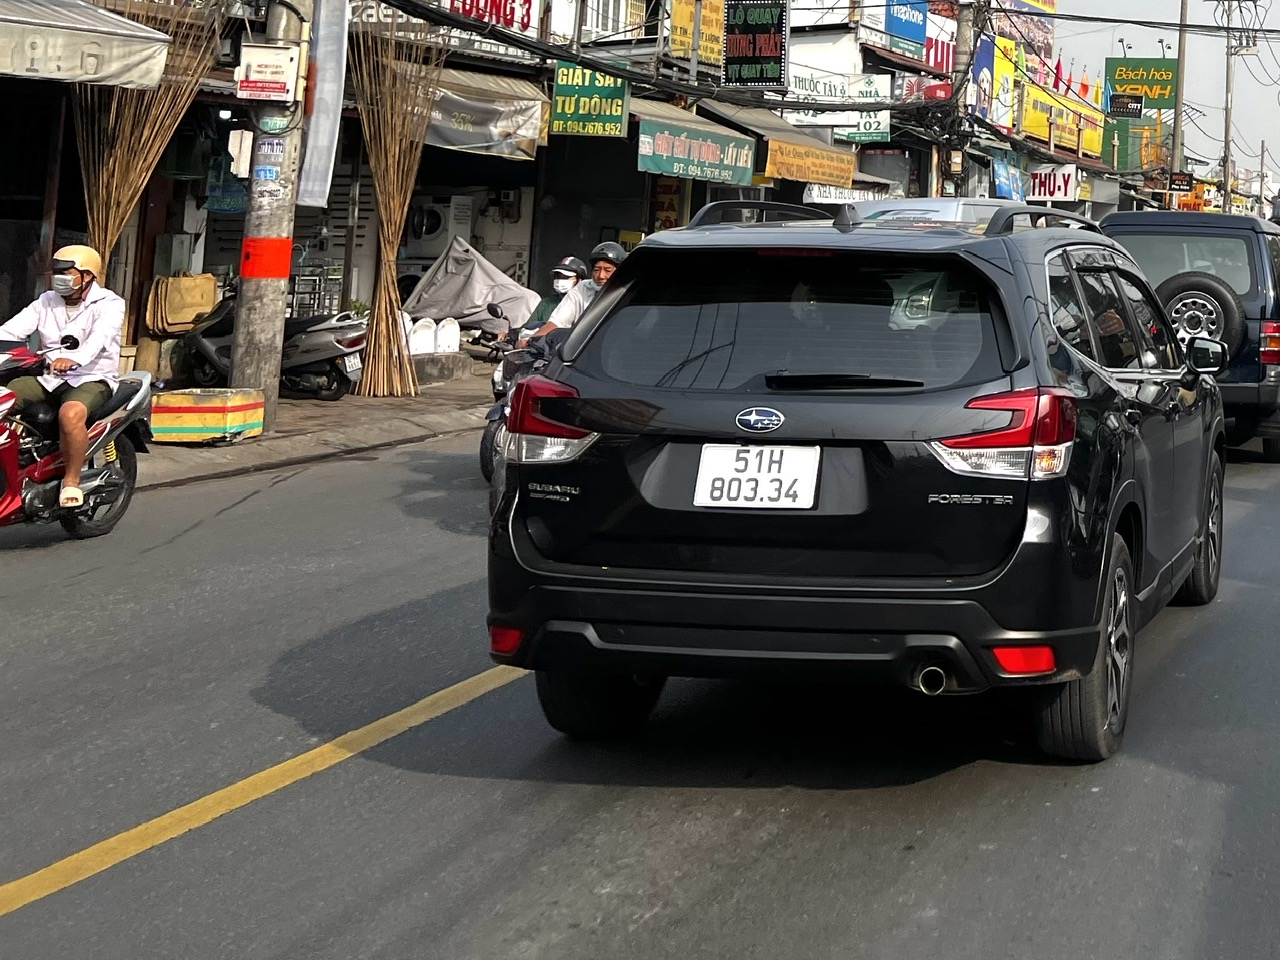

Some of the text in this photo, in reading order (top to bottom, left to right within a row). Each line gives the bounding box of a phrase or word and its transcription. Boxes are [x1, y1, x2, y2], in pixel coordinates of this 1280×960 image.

[729, 5, 780, 25] LÒ QUAY
[755, 27, 782, 56] PHÁT
[558, 66, 592, 89] GIẶT
[1115, 67, 1173, 80] Bách hóa
[793, 74, 838, 97] THUỐC TÂY
[858, 88, 880, 98] NHÀ
[556, 94, 622, 118] TỰ ĐỘNG
[567, 121, 621, 135] 094.7676.952
[857, 121, 881, 131] 102
[1030, 168, 1071, 196] THÚ-Y
[734, 449, 783, 474] 51H
[528, 482, 579, 494] SUBARU
[709, 477, 799, 503] 803.34
[928, 494, 1014, 505] FORESTER
